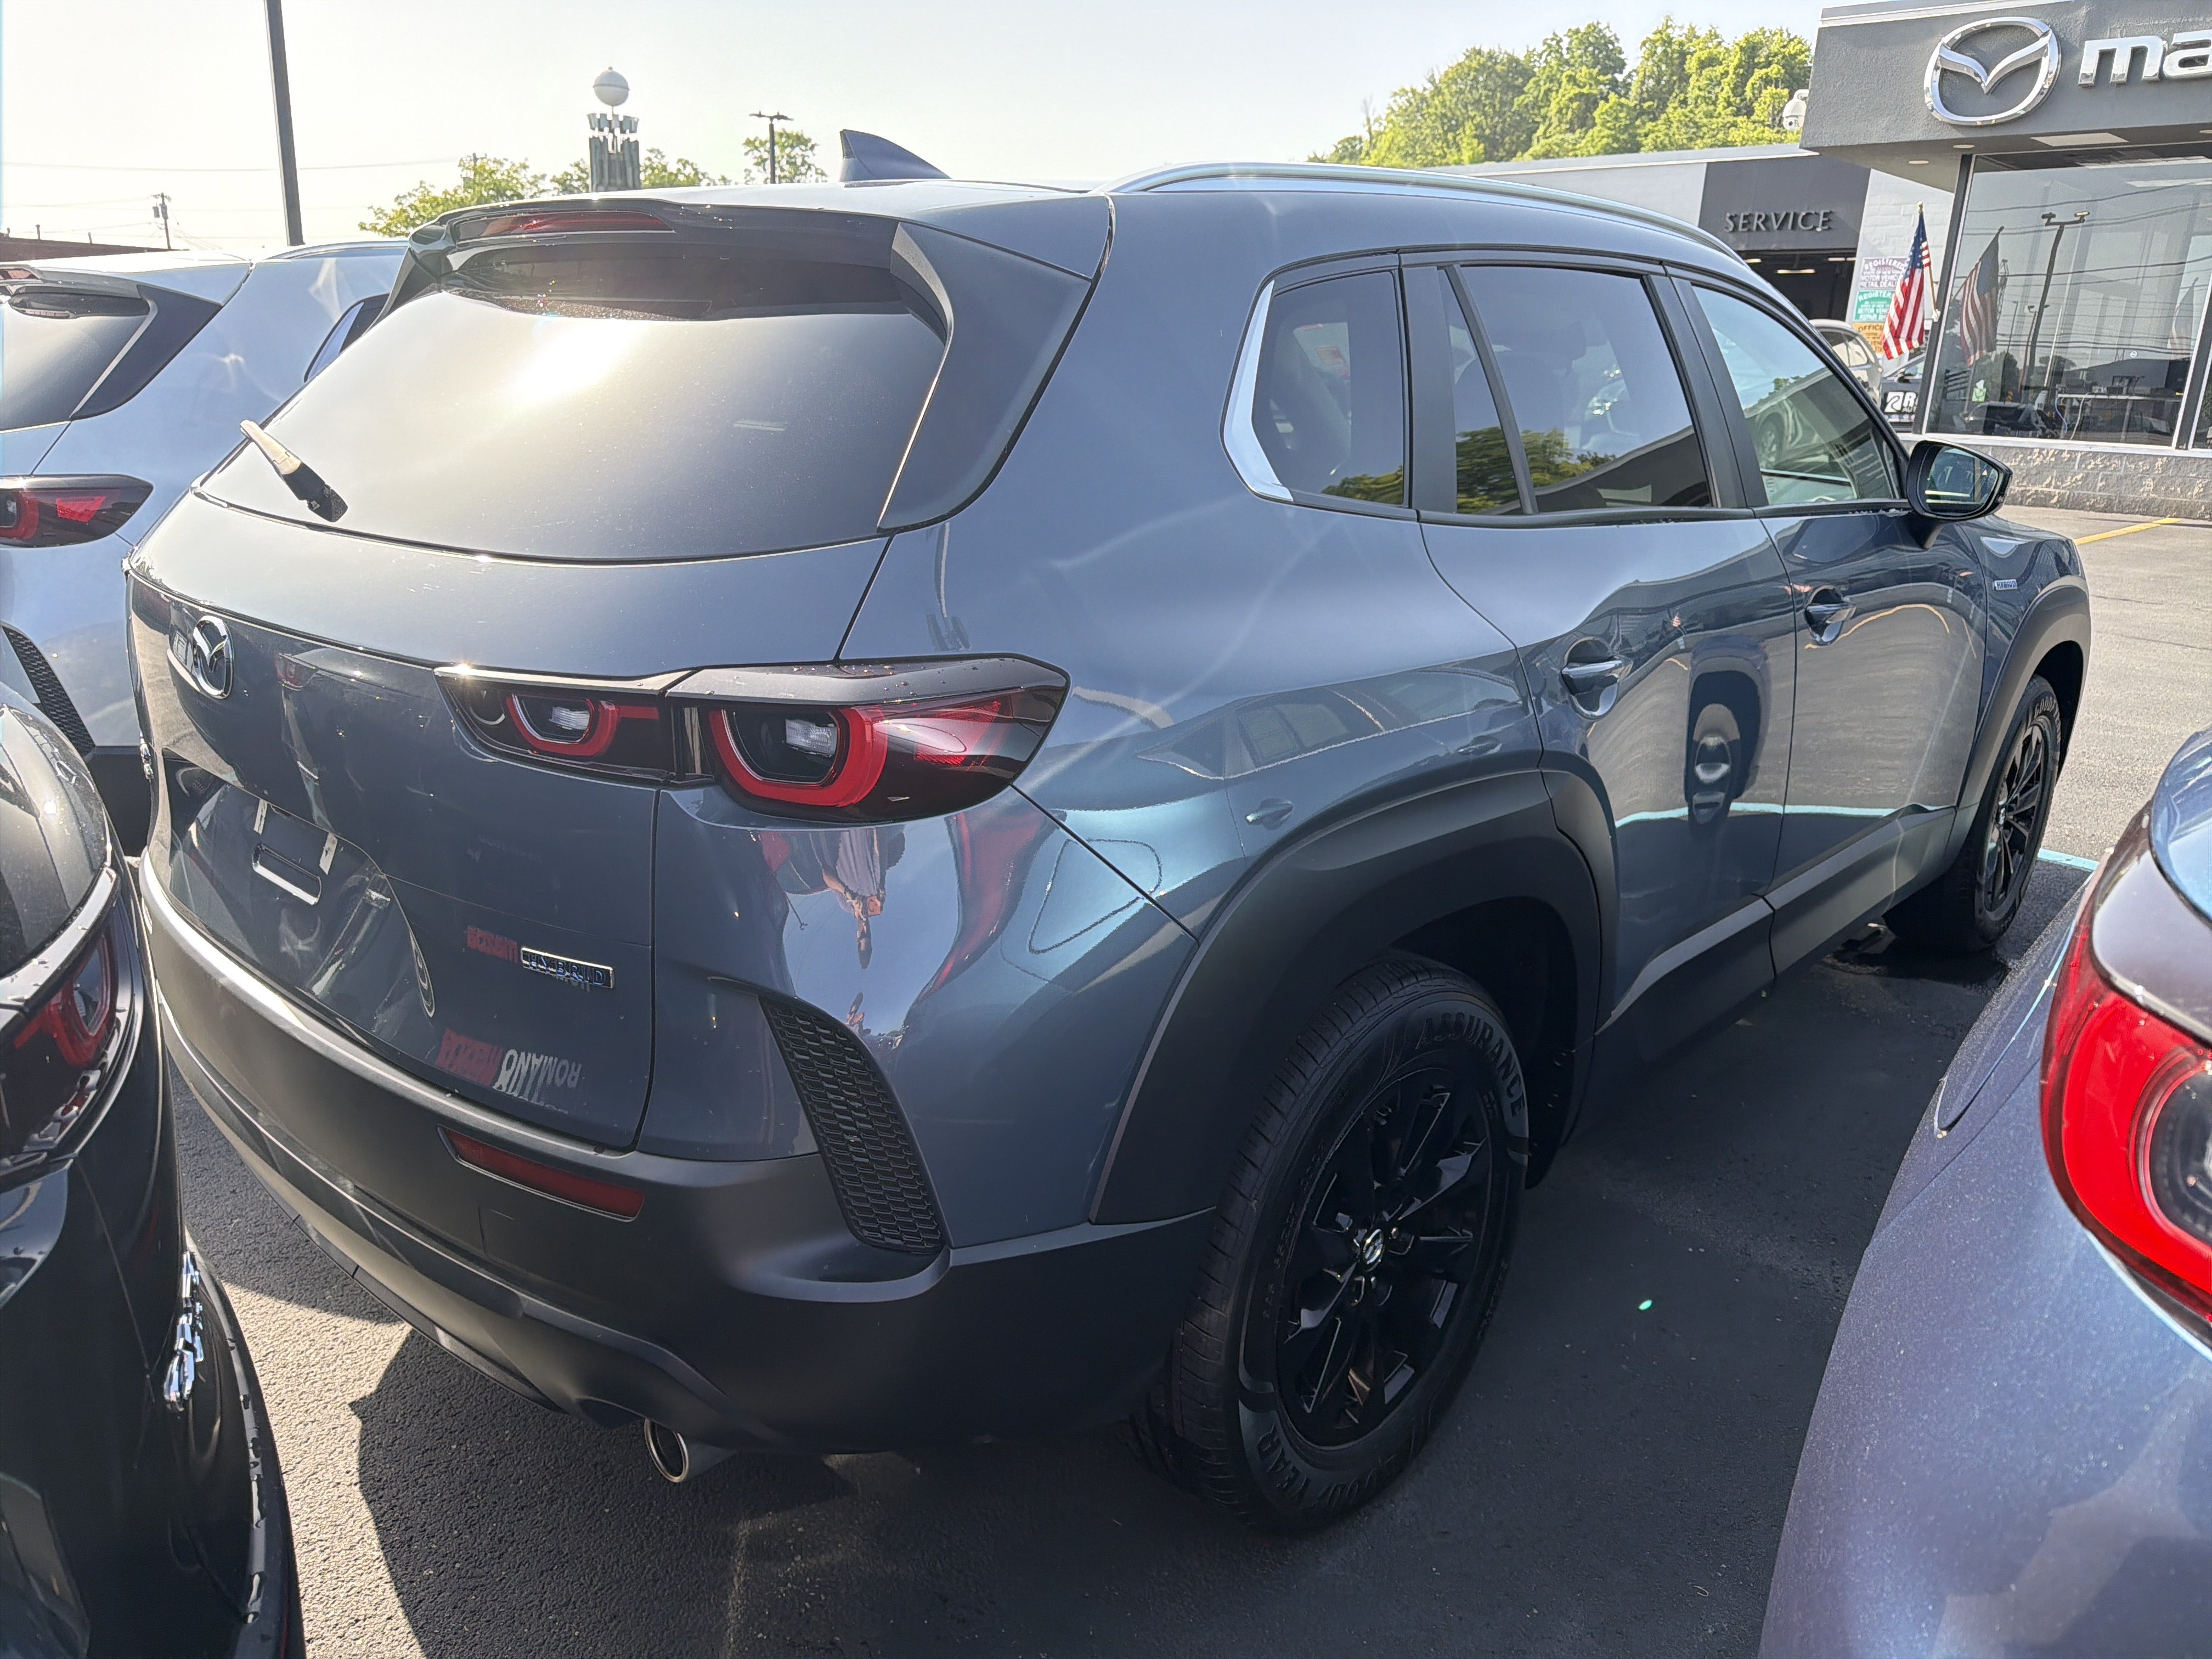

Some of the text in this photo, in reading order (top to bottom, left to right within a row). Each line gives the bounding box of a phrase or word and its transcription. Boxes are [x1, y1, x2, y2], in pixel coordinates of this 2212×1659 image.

[1724, 210, 1832, 232] SERVICE
[528, 952, 607, 986] HYBRID
[1415, 1011, 1525, 1118] ASSURANCE
